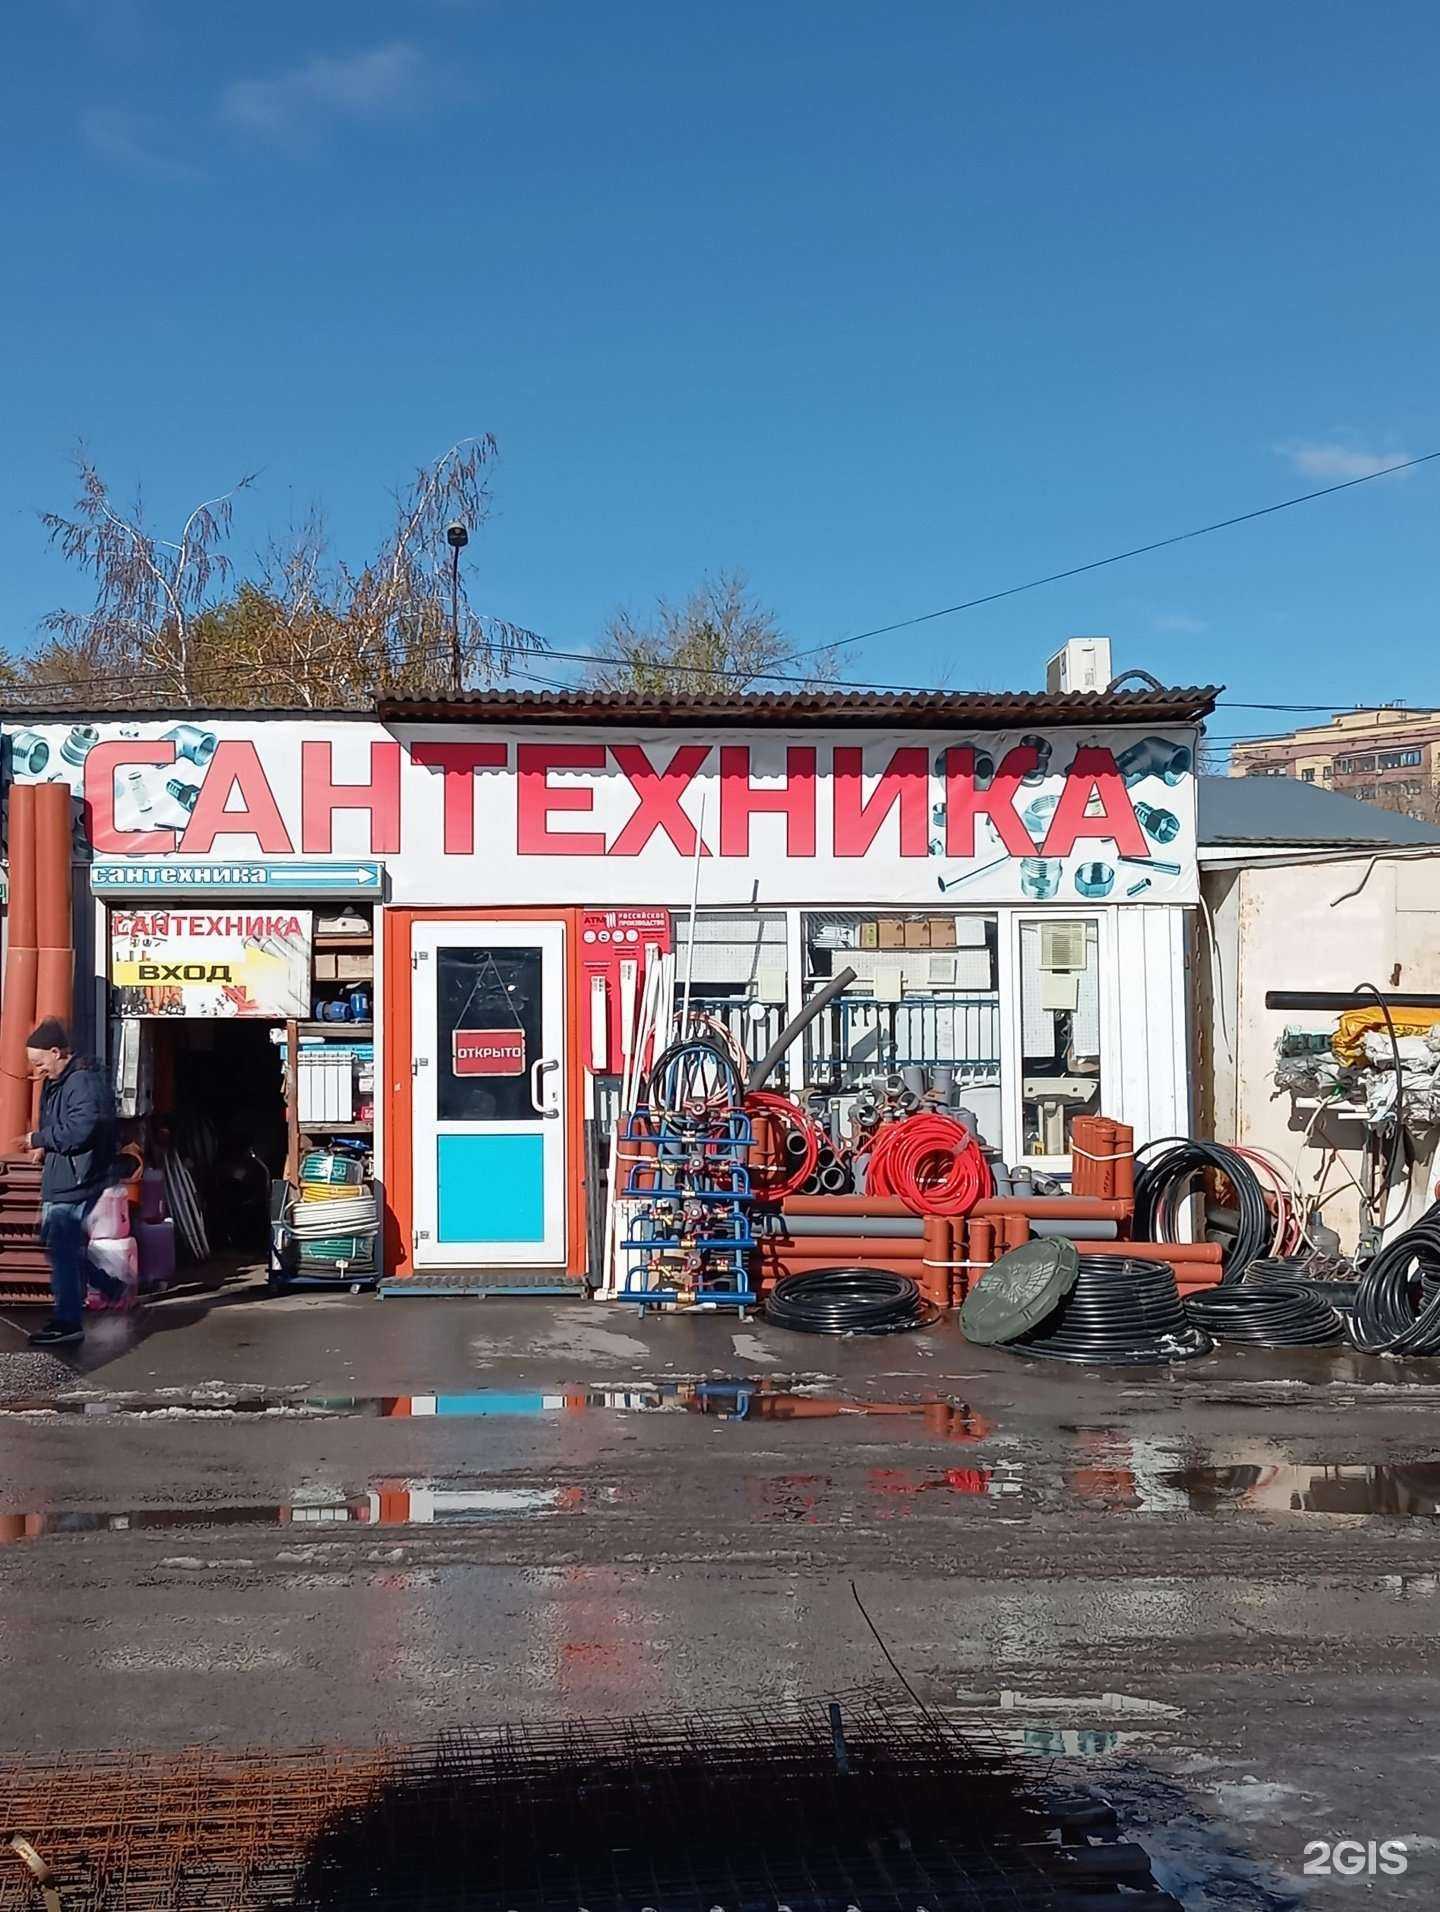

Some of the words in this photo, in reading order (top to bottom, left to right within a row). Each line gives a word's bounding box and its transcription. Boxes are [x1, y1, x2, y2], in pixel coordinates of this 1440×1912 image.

[83, 740, 1152, 858] САНТЕХНИКА
[92, 866, 268, 884] сантехника
[112, 915, 302, 937] САНТЕХНИКА
[138, 964, 232, 982] ВХОД
[457, 1047, 521, 1059] ОТКРЫТО
